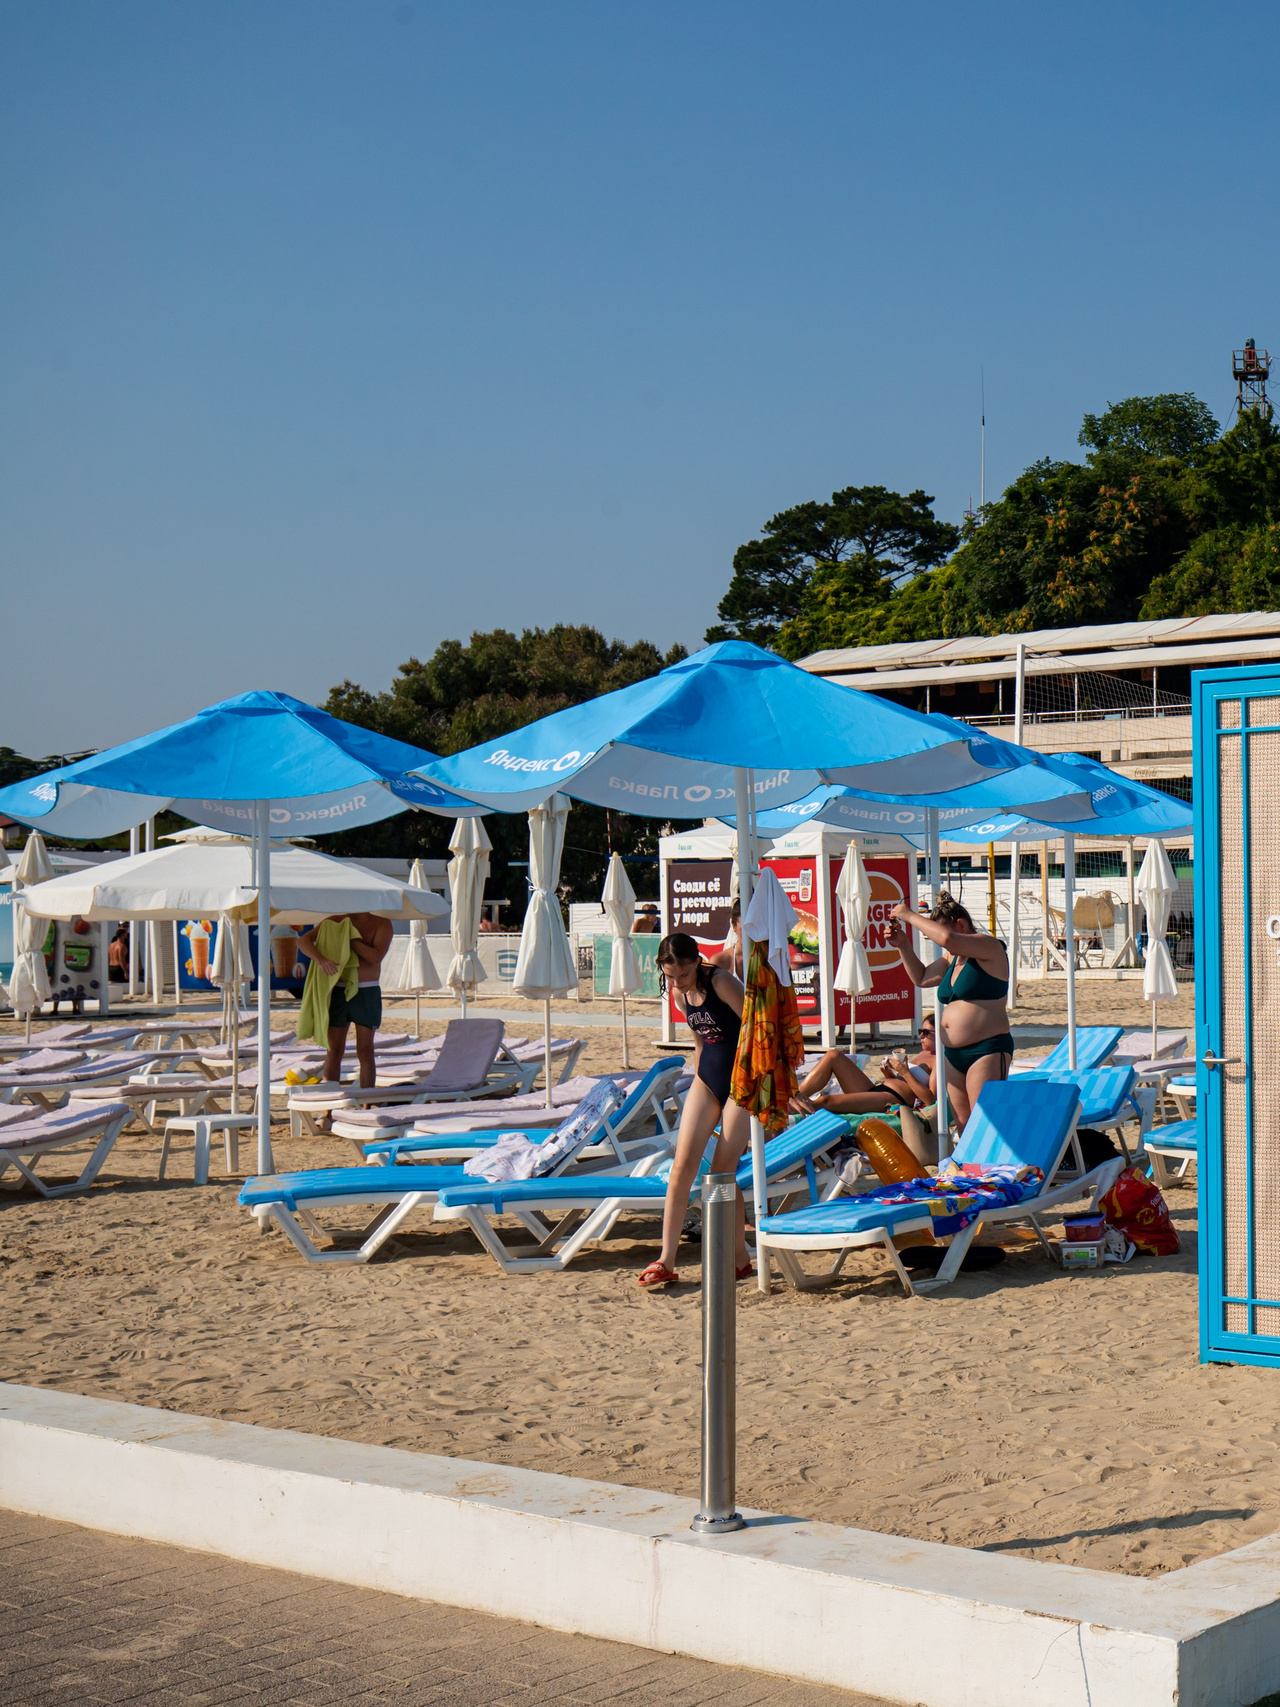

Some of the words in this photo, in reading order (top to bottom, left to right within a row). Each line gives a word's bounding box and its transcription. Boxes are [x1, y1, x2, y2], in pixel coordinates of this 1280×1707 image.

[483, 750, 557, 772] Яндекс
[1092, 784, 1118, 802] авка
[673, 880, 706, 894] Своди
[707, 878, 720, 892] её
[673, 898, 680, 908] в
[682, 896, 732, 912] ресторан
[673, 912, 682, 928] у
[682, 912, 710, 927] моря
[840, 996, 851, 1006] ул.
[688, 1012, 716, 1028] FILA
